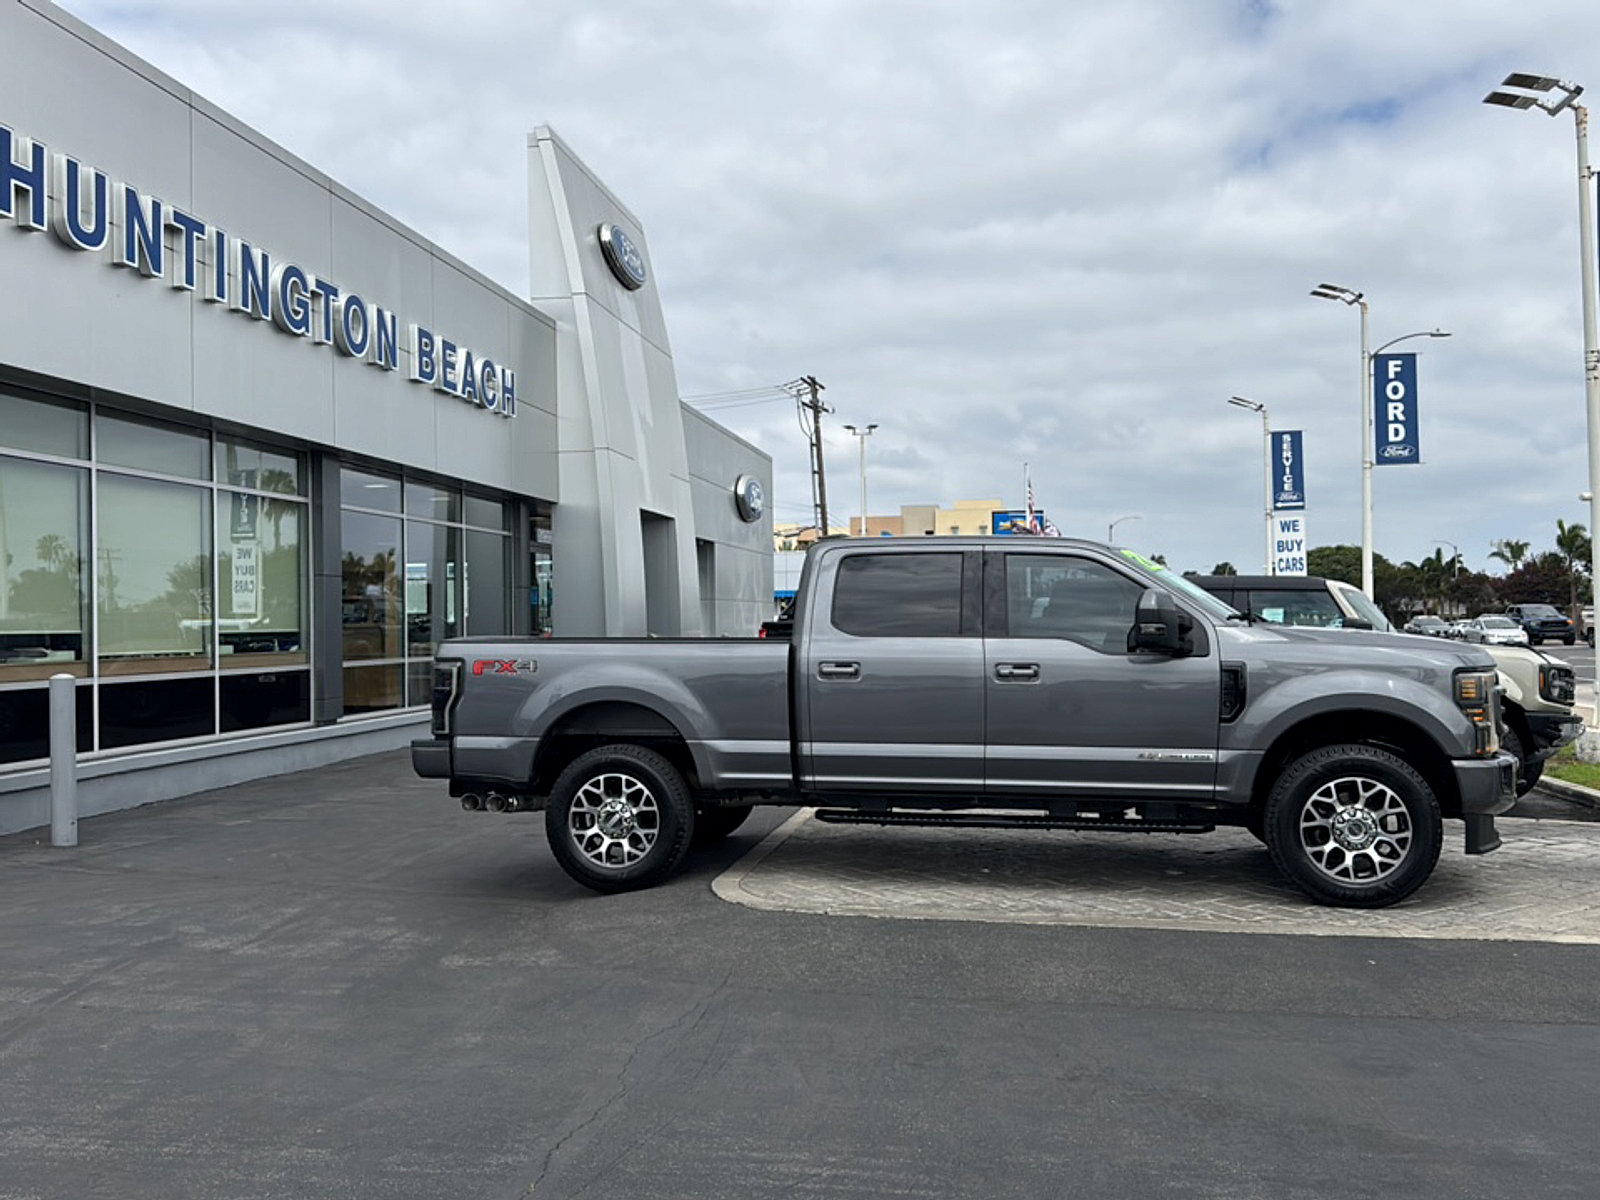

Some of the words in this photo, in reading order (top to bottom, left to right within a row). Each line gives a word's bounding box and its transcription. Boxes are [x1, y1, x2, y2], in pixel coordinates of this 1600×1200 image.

[0, 124, 399, 371] HUNTINGTON
[410, 324, 517, 418] BEACH
[1386, 360, 1406, 443] FORD
[1282, 434, 1293, 491] SERVICE
[1280, 519, 1300, 533] WE
[1277, 540, 1303, 552] BUY
[1278, 557, 1304, 572] CARS
[473, 660, 537, 675] FX4
